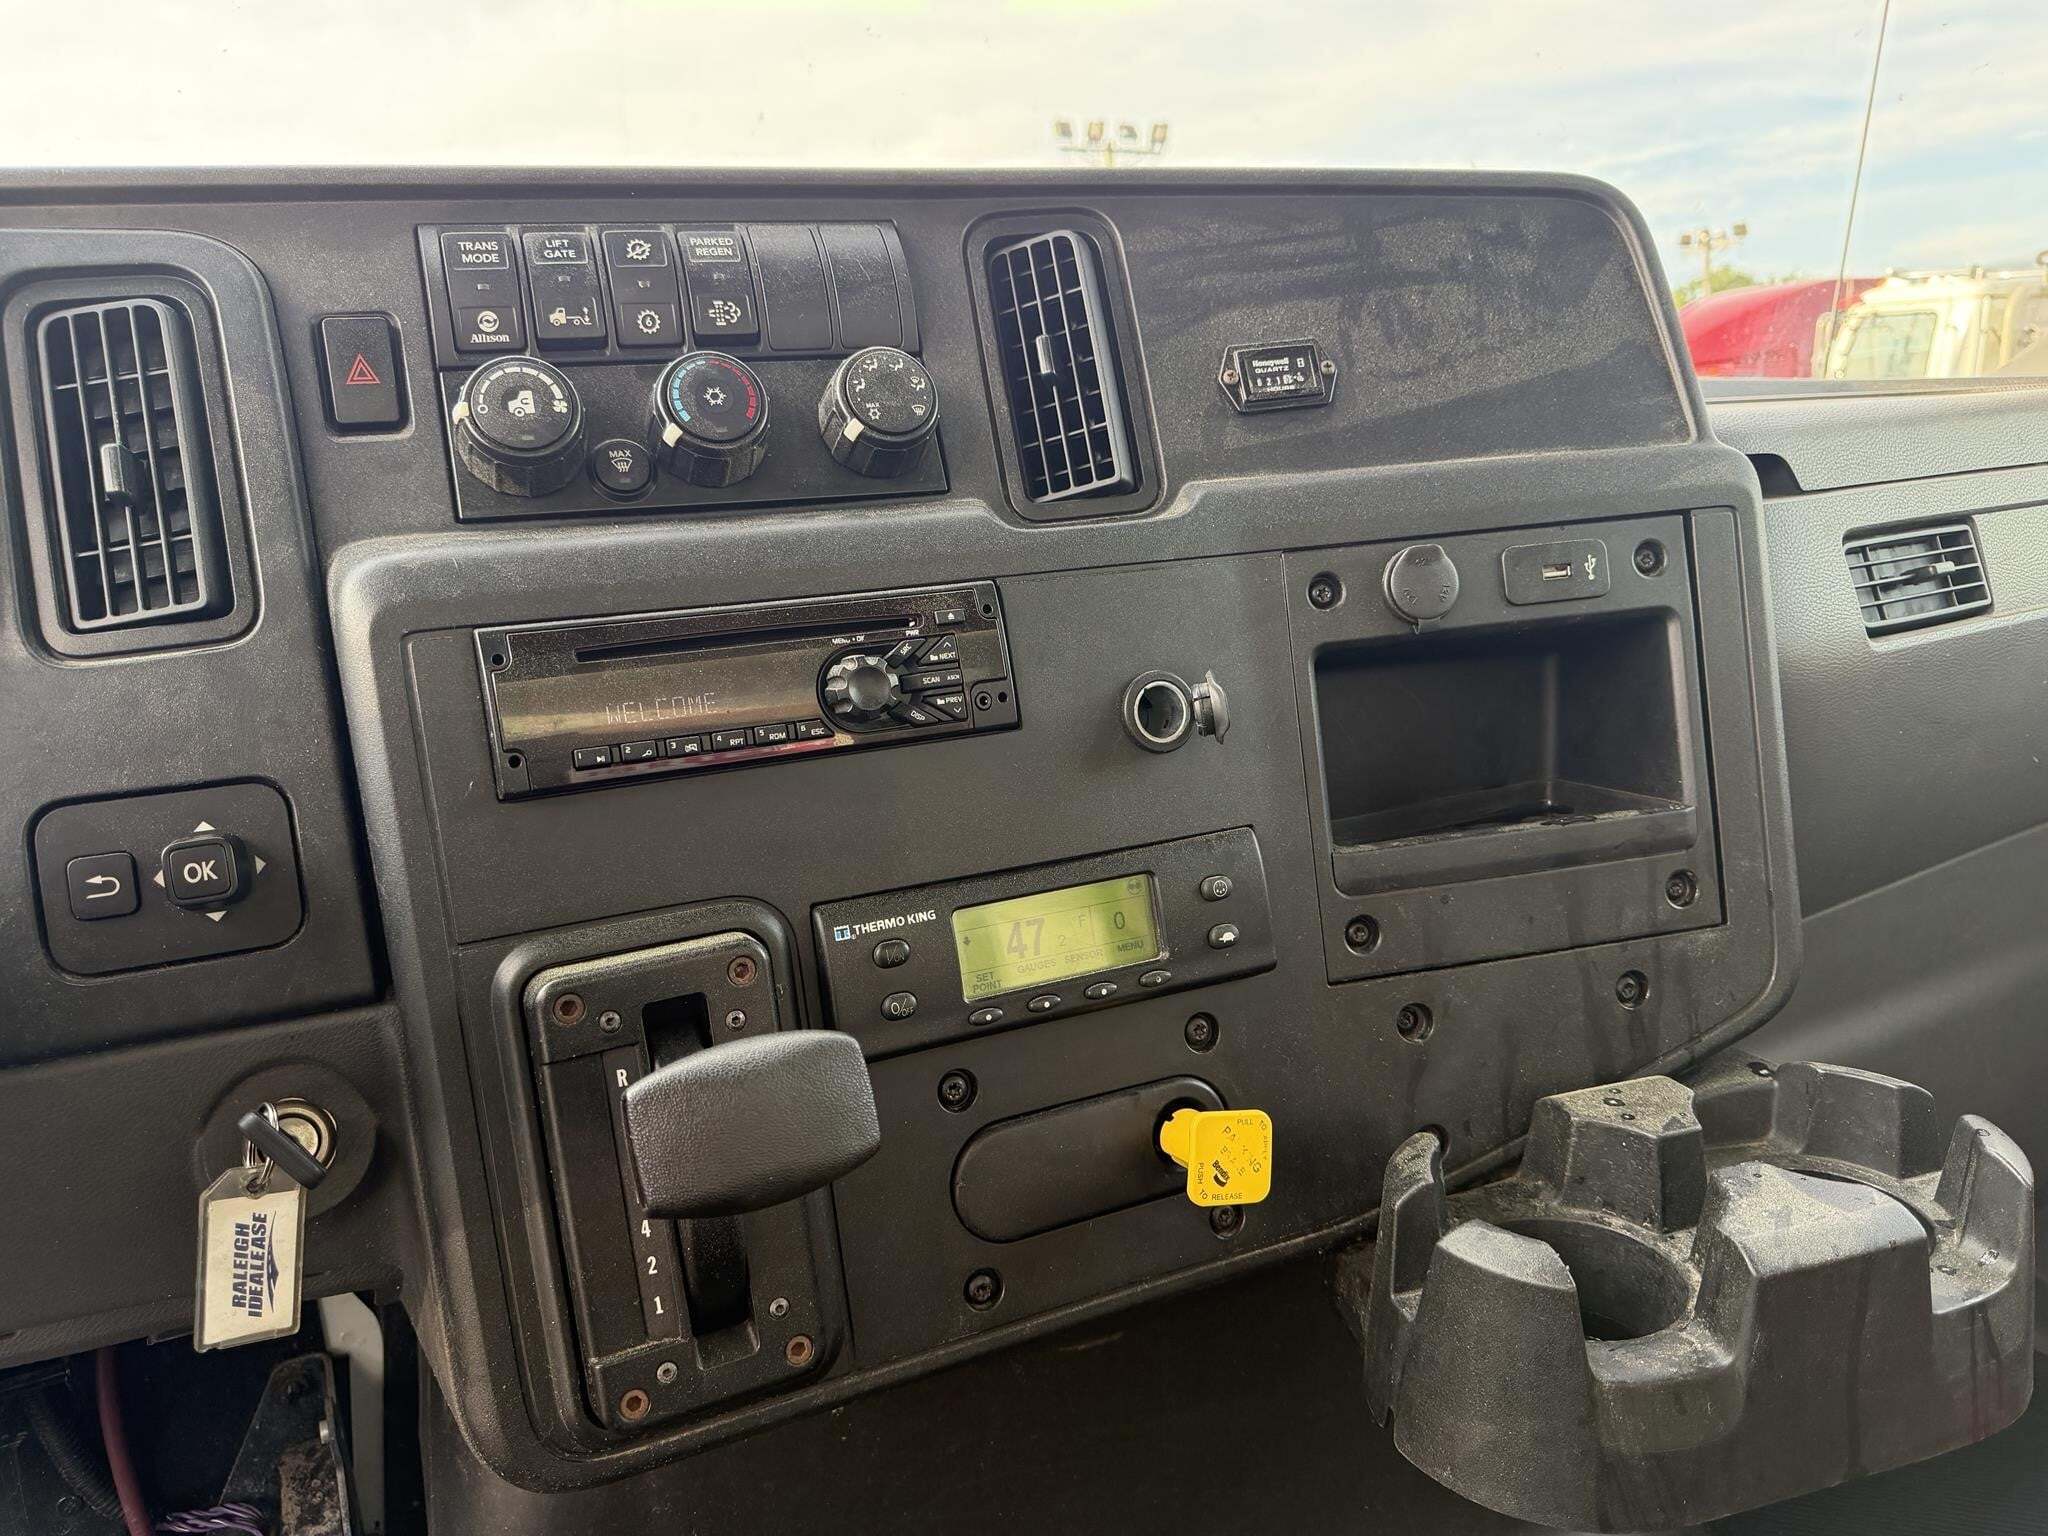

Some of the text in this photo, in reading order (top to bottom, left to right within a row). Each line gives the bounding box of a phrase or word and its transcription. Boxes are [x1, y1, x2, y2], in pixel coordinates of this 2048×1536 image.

[458, 241, 498, 251] TRANS
[545, 239, 569, 248] LIFT
[689, 237, 734, 246] PARKED
[543, 249, 577, 259] GATE
[695, 247, 733, 256] REGEN
[462, 253, 499, 263] MODE
[470, 332, 510, 343] Allison
[1255, 366, 1290, 374] QUARTZ
[608, 449, 632, 458] MAX
[900, 642, 912, 656] SRC
[939, 651, 956, 660] NEXT
[922, 676, 940, 685] SCAN
[945, 695, 963, 704] PREV
[606, 692, 717, 725] WELCOME
[910, 709, 926, 721] DISP
[759, 729, 765, 737] 5
[800, 724, 806, 732] 6
[811, 727, 826, 736] ESC
[716, 735, 722, 743] 4
[729, 737, 745, 747] RPT
[625, 746, 631, 754] 2
[670, 741, 676, 749] 3
[183, 859, 219, 884] OK
[852, 916, 905, 936] THERMO
[907, 909, 937, 925] KING
[1006, 917, 1045, 960] 47
[1117, 940, 1145, 953] MENU
[1064, 948, 1104, 966] SENSOR
[1016, 958, 1057, 974] GAUGES
[975, 971, 994, 982] SET
[972, 978, 1002, 993] POINT
[615, 1068, 629, 1088] R
[1237, 1118, 1254, 1126] PULL
[1211, 1192, 1243, 1201] RELEASE
[640, 1219, 651, 1238] 4
[231, 1222, 251, 1309] RALEIGH
[247, 1211, 268, 1318] IDEALEASE
[646, 1255, 658, 1275] 2
[653, 1295, 664, 1315] 1
